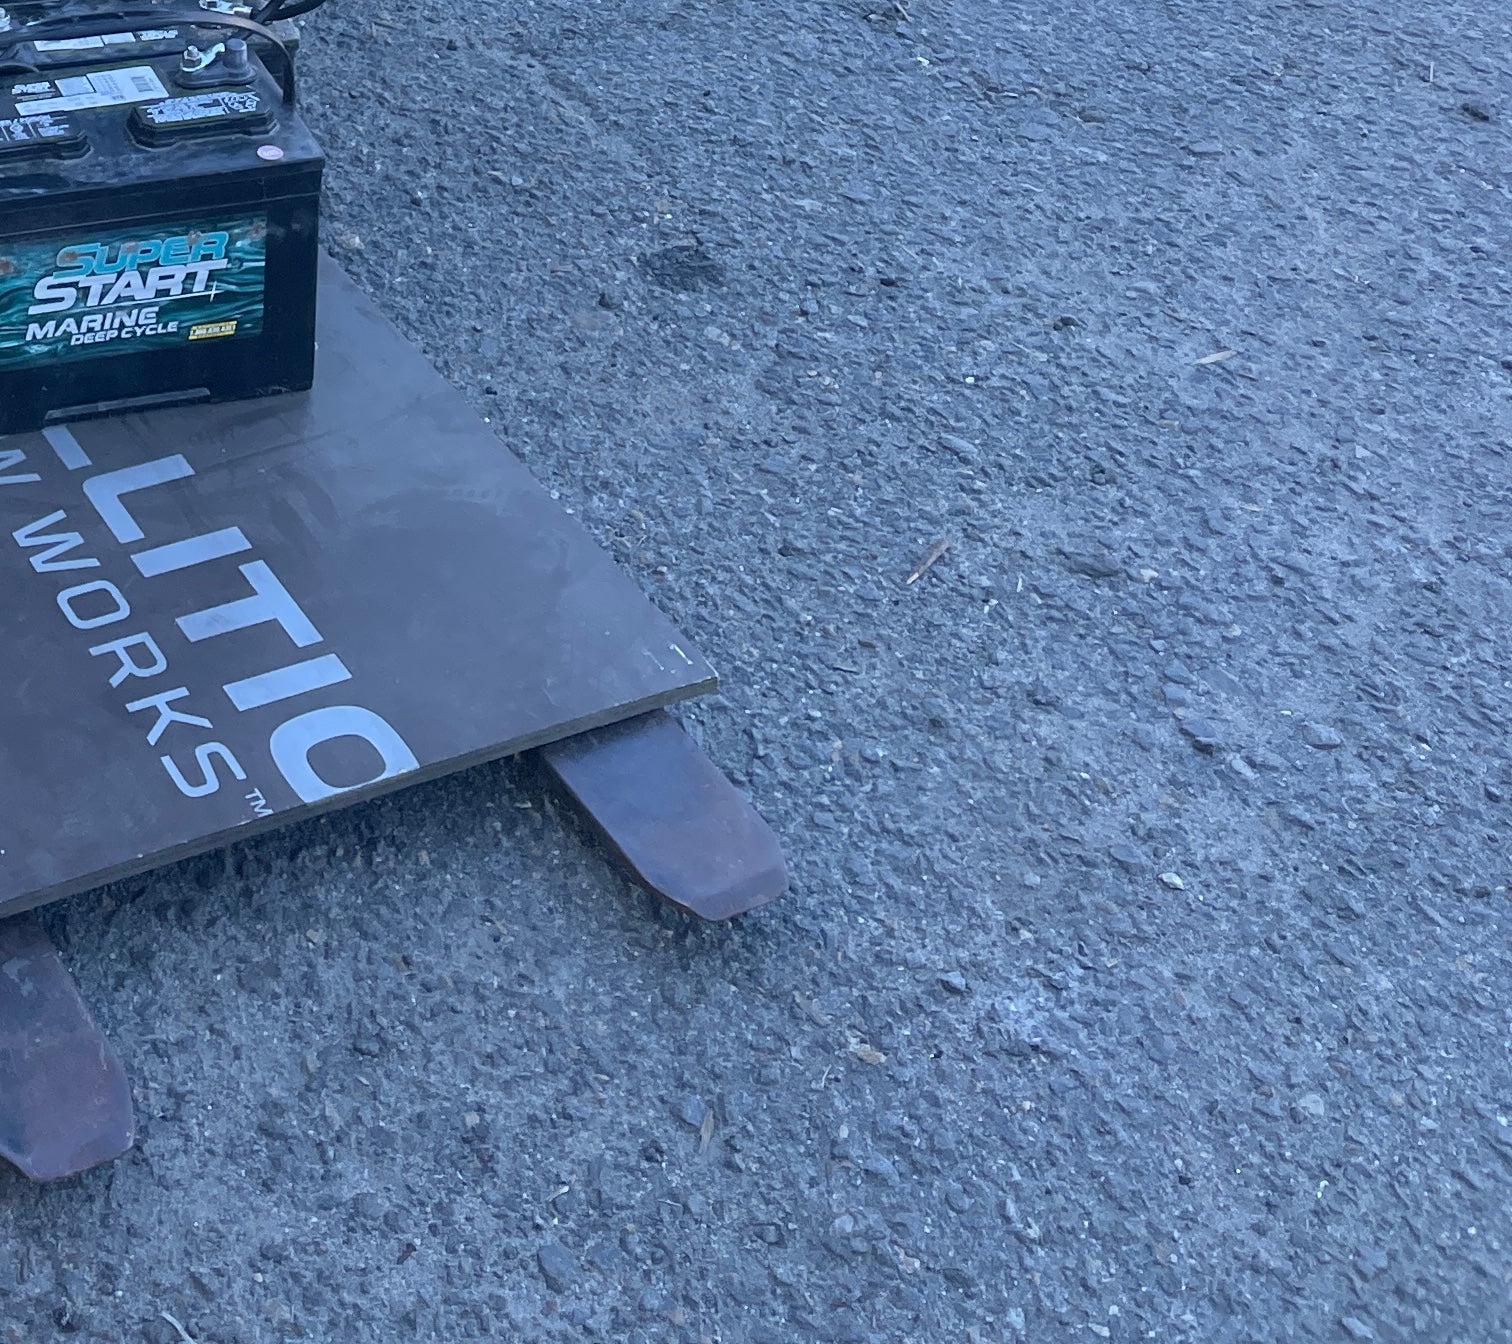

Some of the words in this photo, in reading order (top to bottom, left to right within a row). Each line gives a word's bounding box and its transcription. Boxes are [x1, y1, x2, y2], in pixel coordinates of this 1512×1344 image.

[53, 231, 229, 279] SUPER
[28, 258, 230, 316] START
[25, 306, 160, 341] MARINE
[70, 329, 119, 347] DEEP
[120, 320, 179, 340] CYCLE
[12, 509, 247, 798] WORKS
